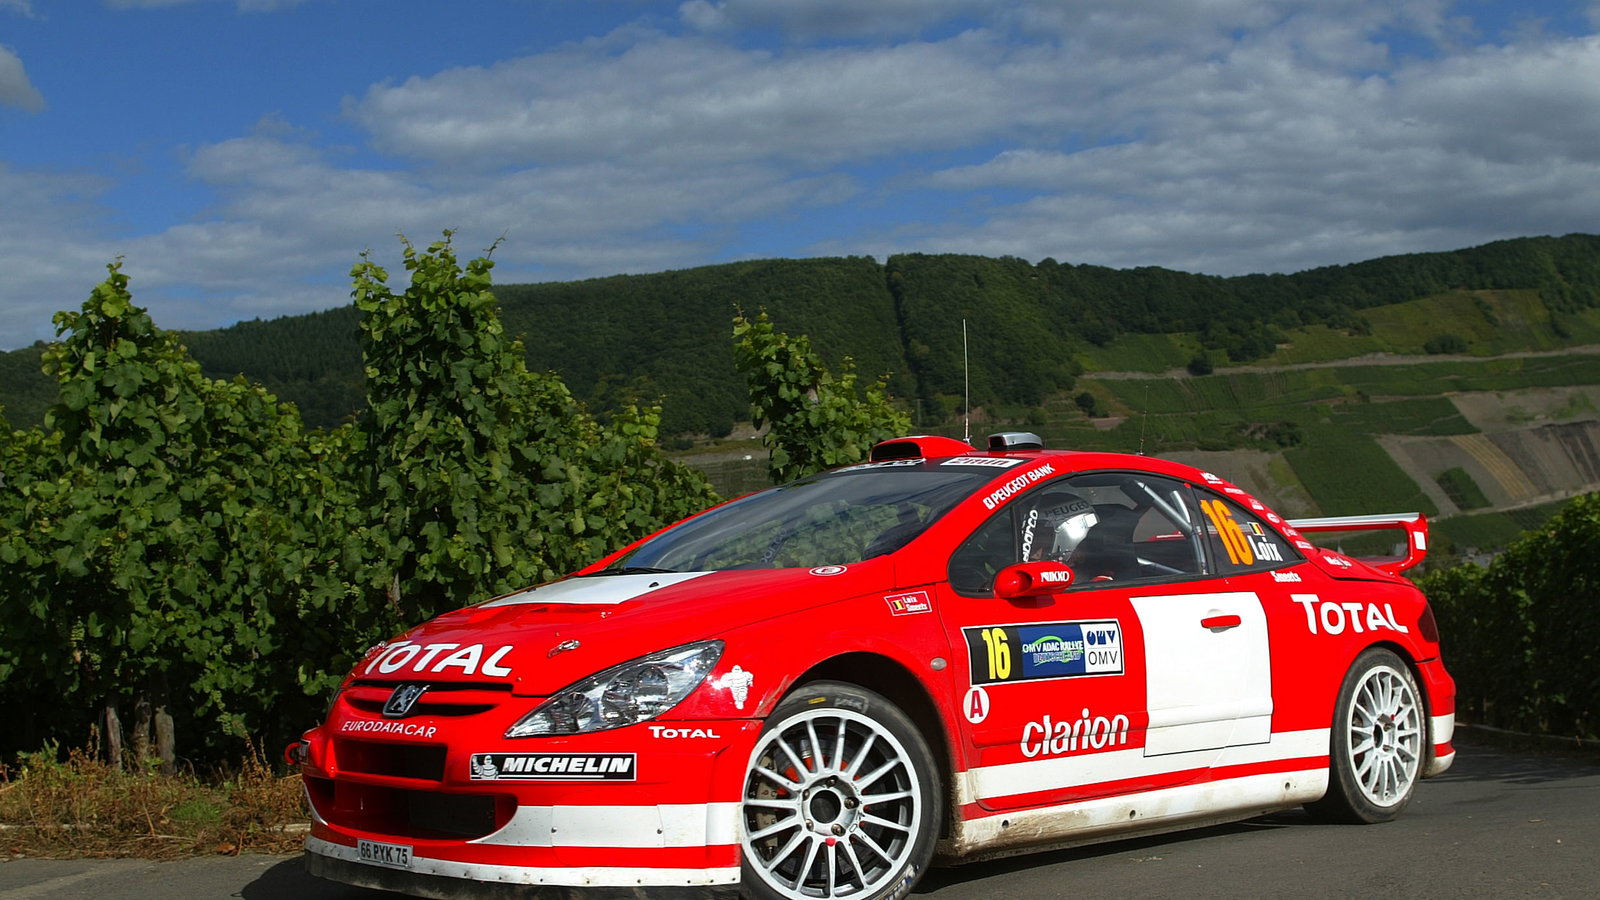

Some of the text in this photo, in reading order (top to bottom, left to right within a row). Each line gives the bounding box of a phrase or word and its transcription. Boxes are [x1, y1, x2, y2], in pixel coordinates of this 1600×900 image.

[991, 463, 1056, 504] PEUGEOT BANK
[1200, 498, 1254, 566] 16
[1290, 593, 1409, 636] TOTAL
[364, 640, 514, 677] TOTAL
[981, 627, 1012, 680] 16
[1022, 640, 1084, 653] OMV ADAC RALLYE
[1088, 650, 1118, 666] OMV
[969, 690, 984, 719] A
[341, 720, 437, 738] EURODATACAR
[648, 726, 721, 739] TOTAL
[501, 757, 633, 773] MICHELIN
[361, 842, 408, 864] 66 PYK 75
